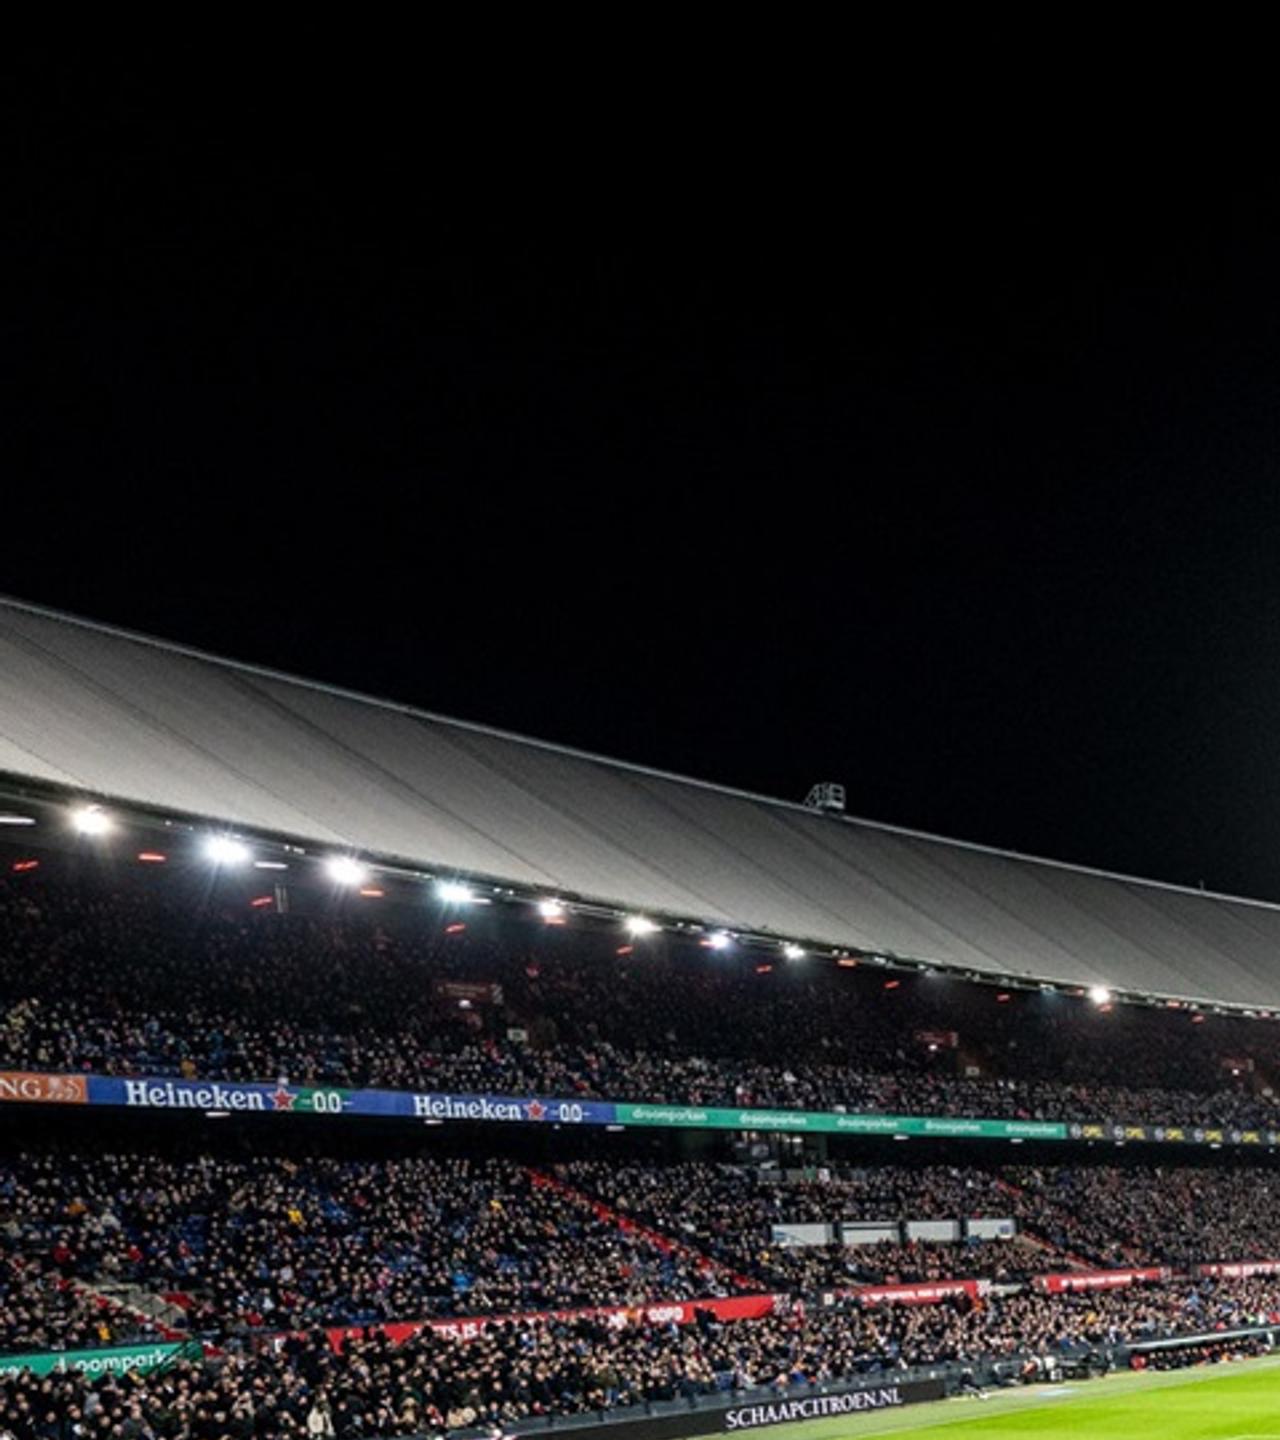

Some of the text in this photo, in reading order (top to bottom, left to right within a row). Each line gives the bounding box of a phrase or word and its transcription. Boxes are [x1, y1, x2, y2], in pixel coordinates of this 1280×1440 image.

[0, 1079, 41, 1099] NG
[124, 1080, 265, 1110] Heineken
[413, 1095, 522, 1120] Heineken
[725, 1387, 904, 1429] SCHAAPCITROEN.NL
